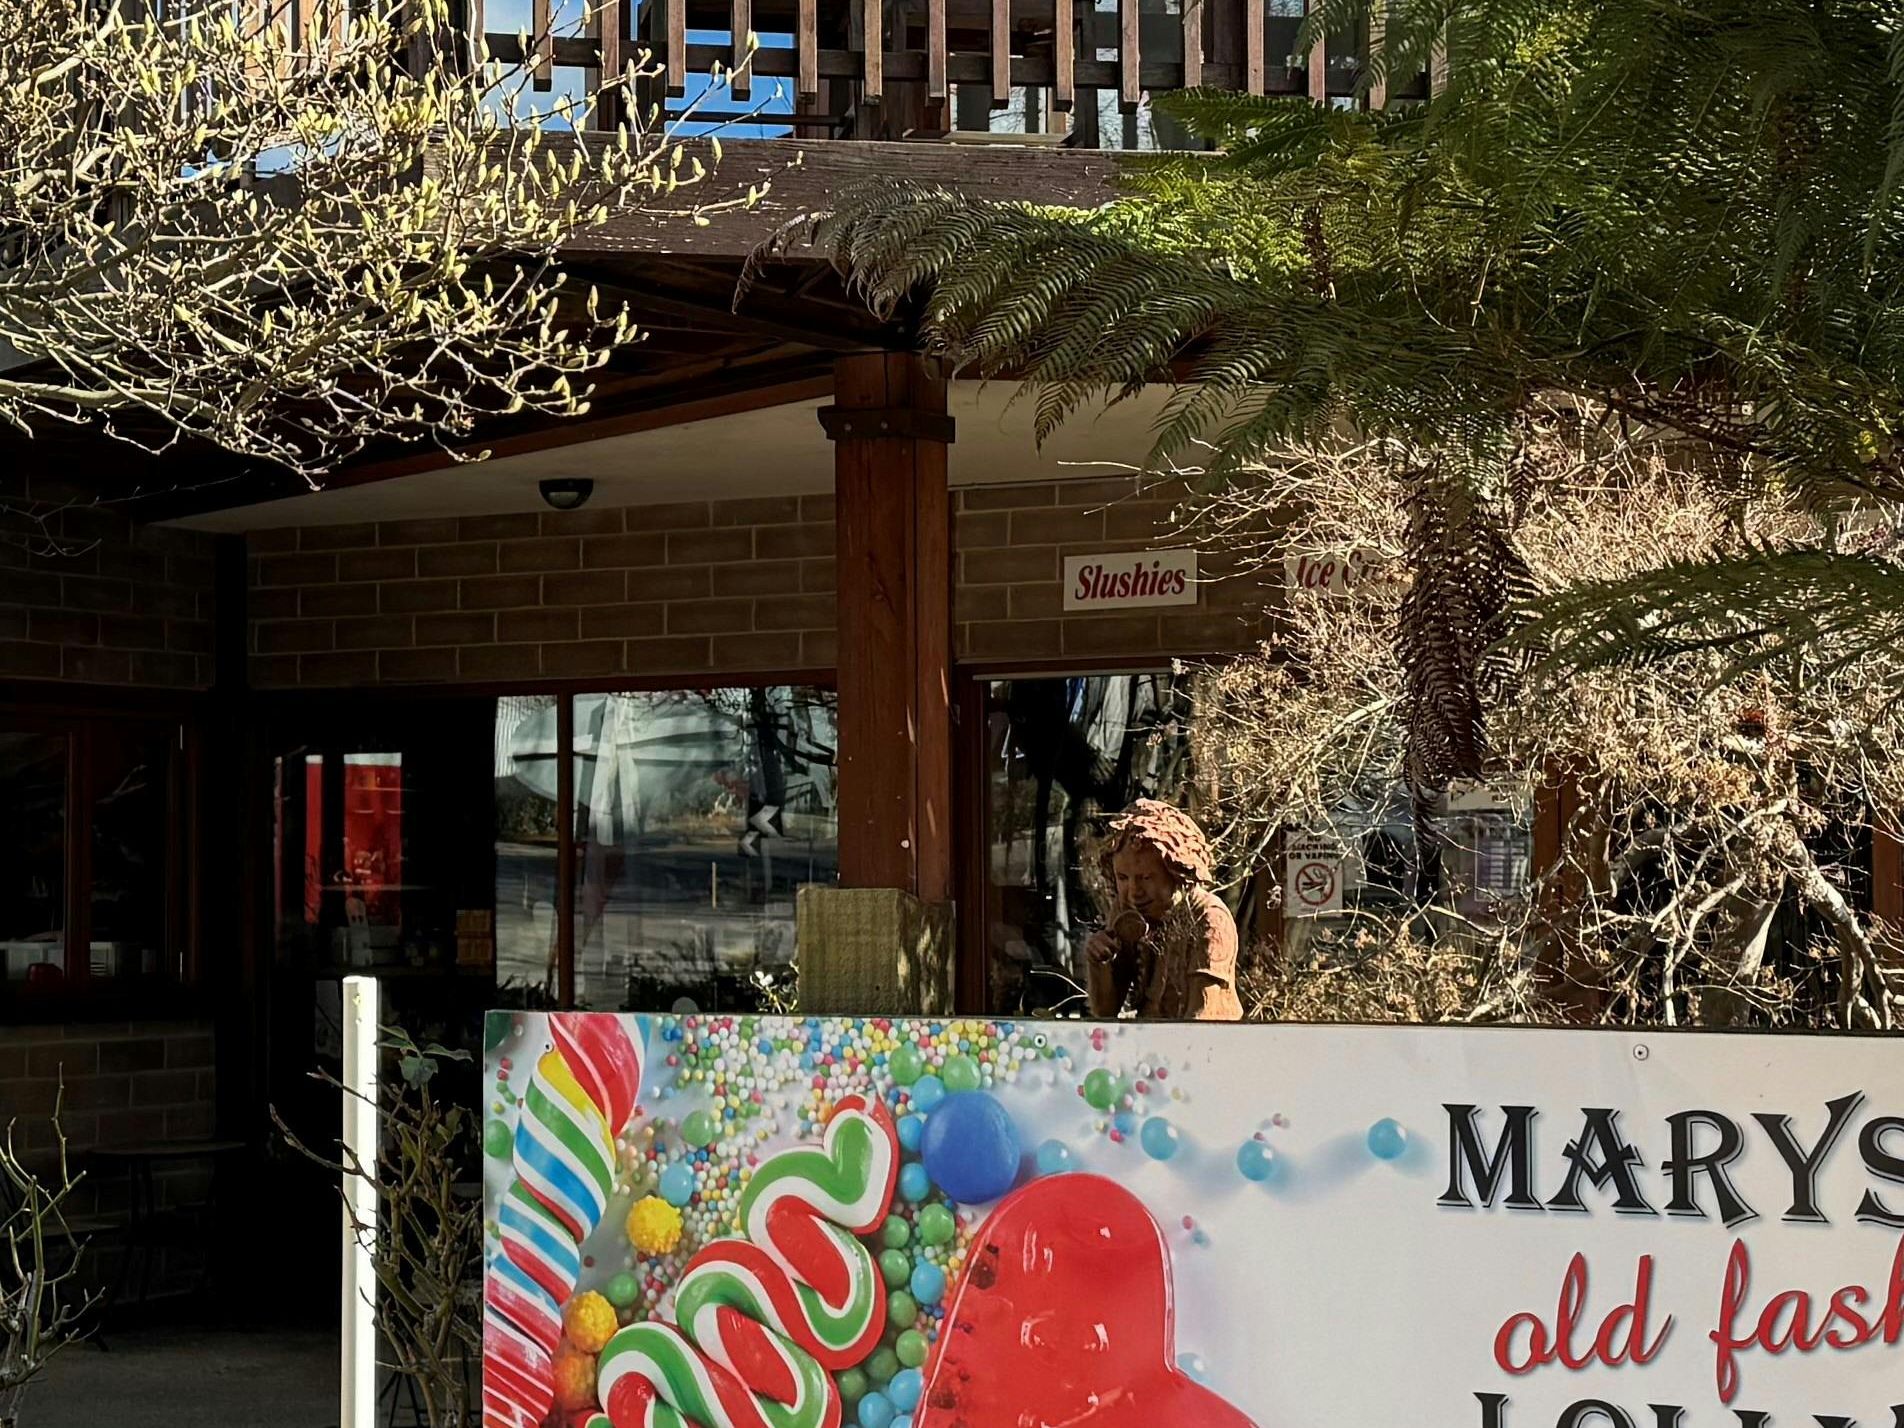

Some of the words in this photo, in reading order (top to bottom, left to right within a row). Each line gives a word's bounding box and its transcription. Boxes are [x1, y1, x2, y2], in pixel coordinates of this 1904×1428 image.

[1074, 560, 1186, 601] Slushies
[1296, 556, 1335, 590] Ice
[1495, 1252, 1674, 1374] old
